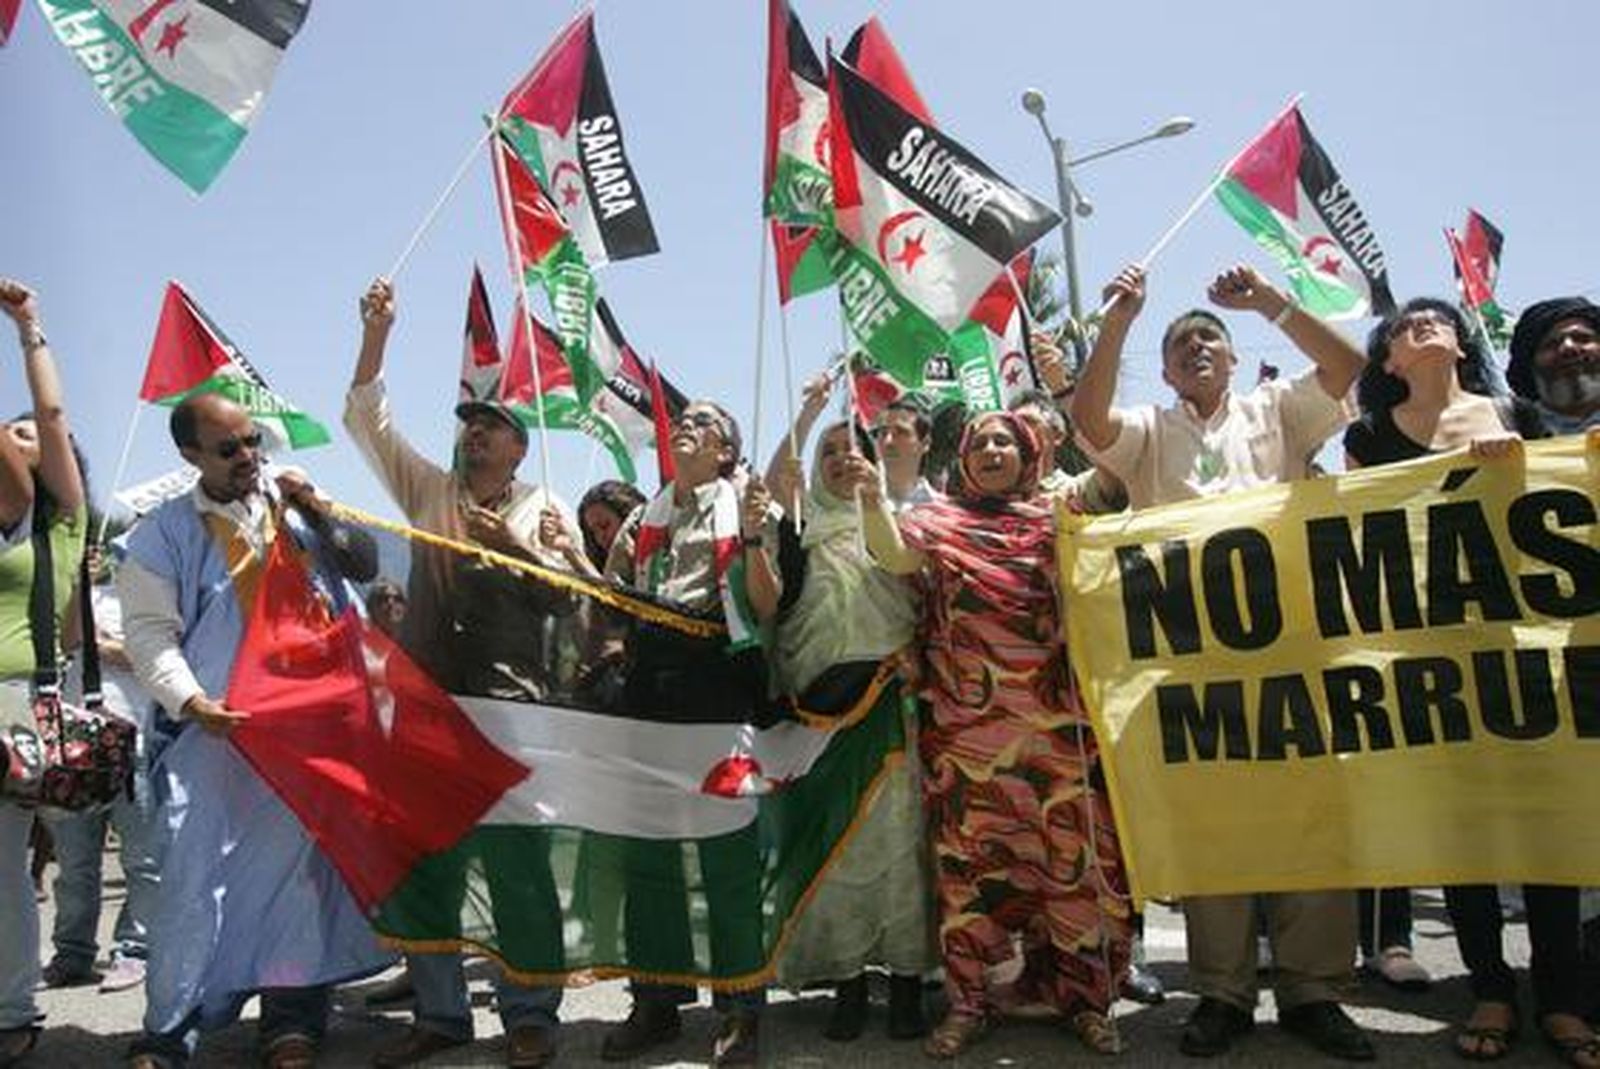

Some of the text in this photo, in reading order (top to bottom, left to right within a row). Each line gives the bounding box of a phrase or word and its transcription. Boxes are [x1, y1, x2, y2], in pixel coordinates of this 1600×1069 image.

[579, 115, 638, 220] SAHARA
[888, 126, 994, 226] SAHARA
[1317, 180, 1384, 279] SAHARA
[1116, 467, 1600, 660] NO MÁS
